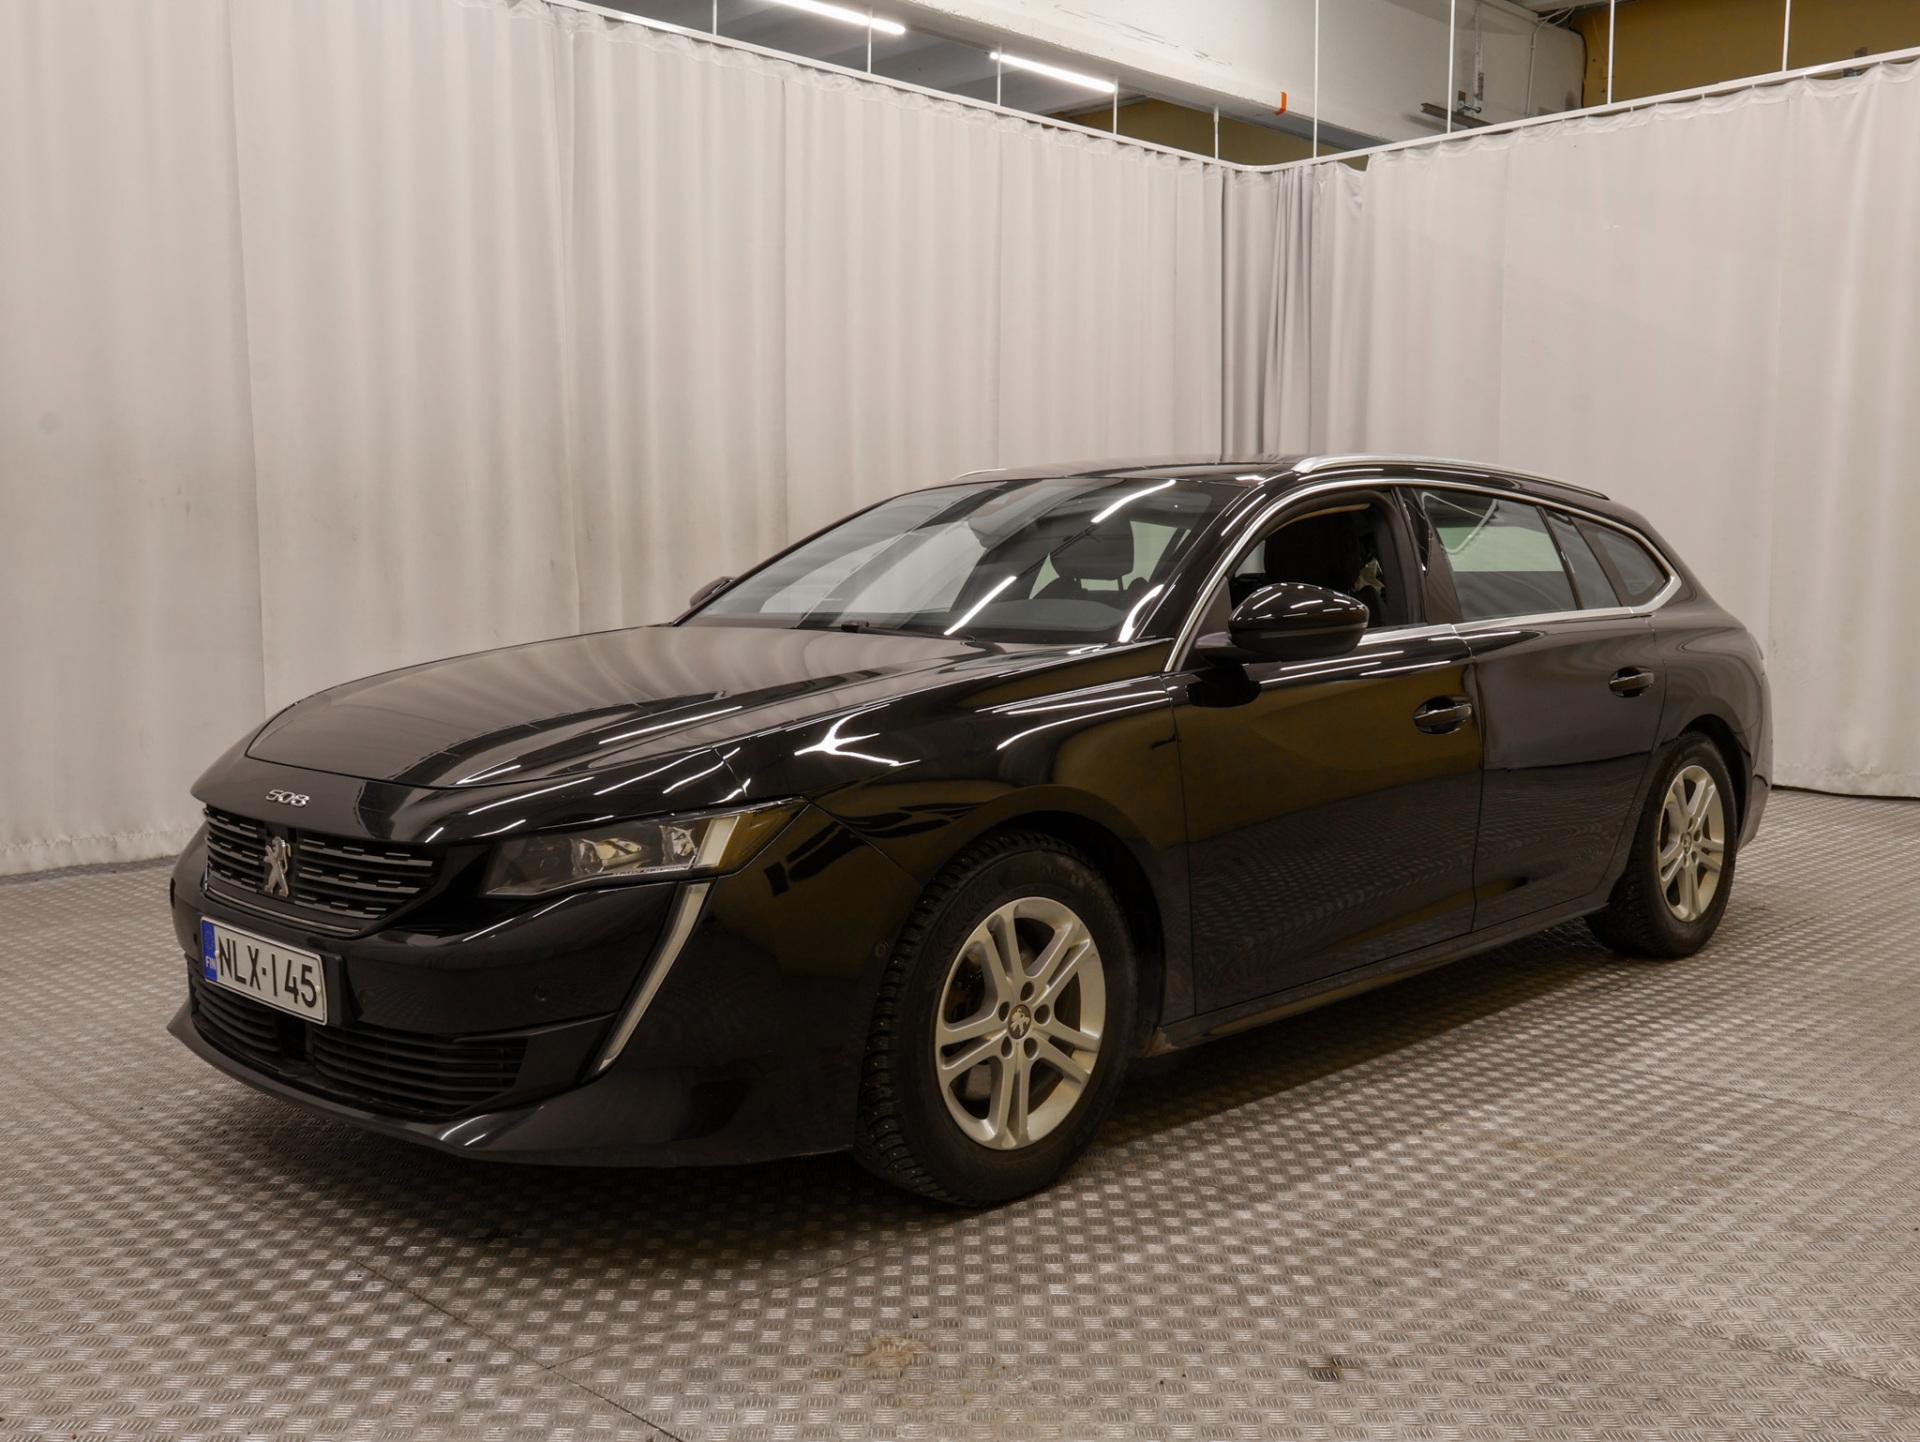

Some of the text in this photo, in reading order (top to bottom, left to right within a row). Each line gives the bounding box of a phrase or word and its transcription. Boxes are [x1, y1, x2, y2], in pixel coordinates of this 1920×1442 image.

[265, 789, 310, 807] 508
[205, 955, 217, 970] FIN
[218, 936, 317, 1008] NLX-145
